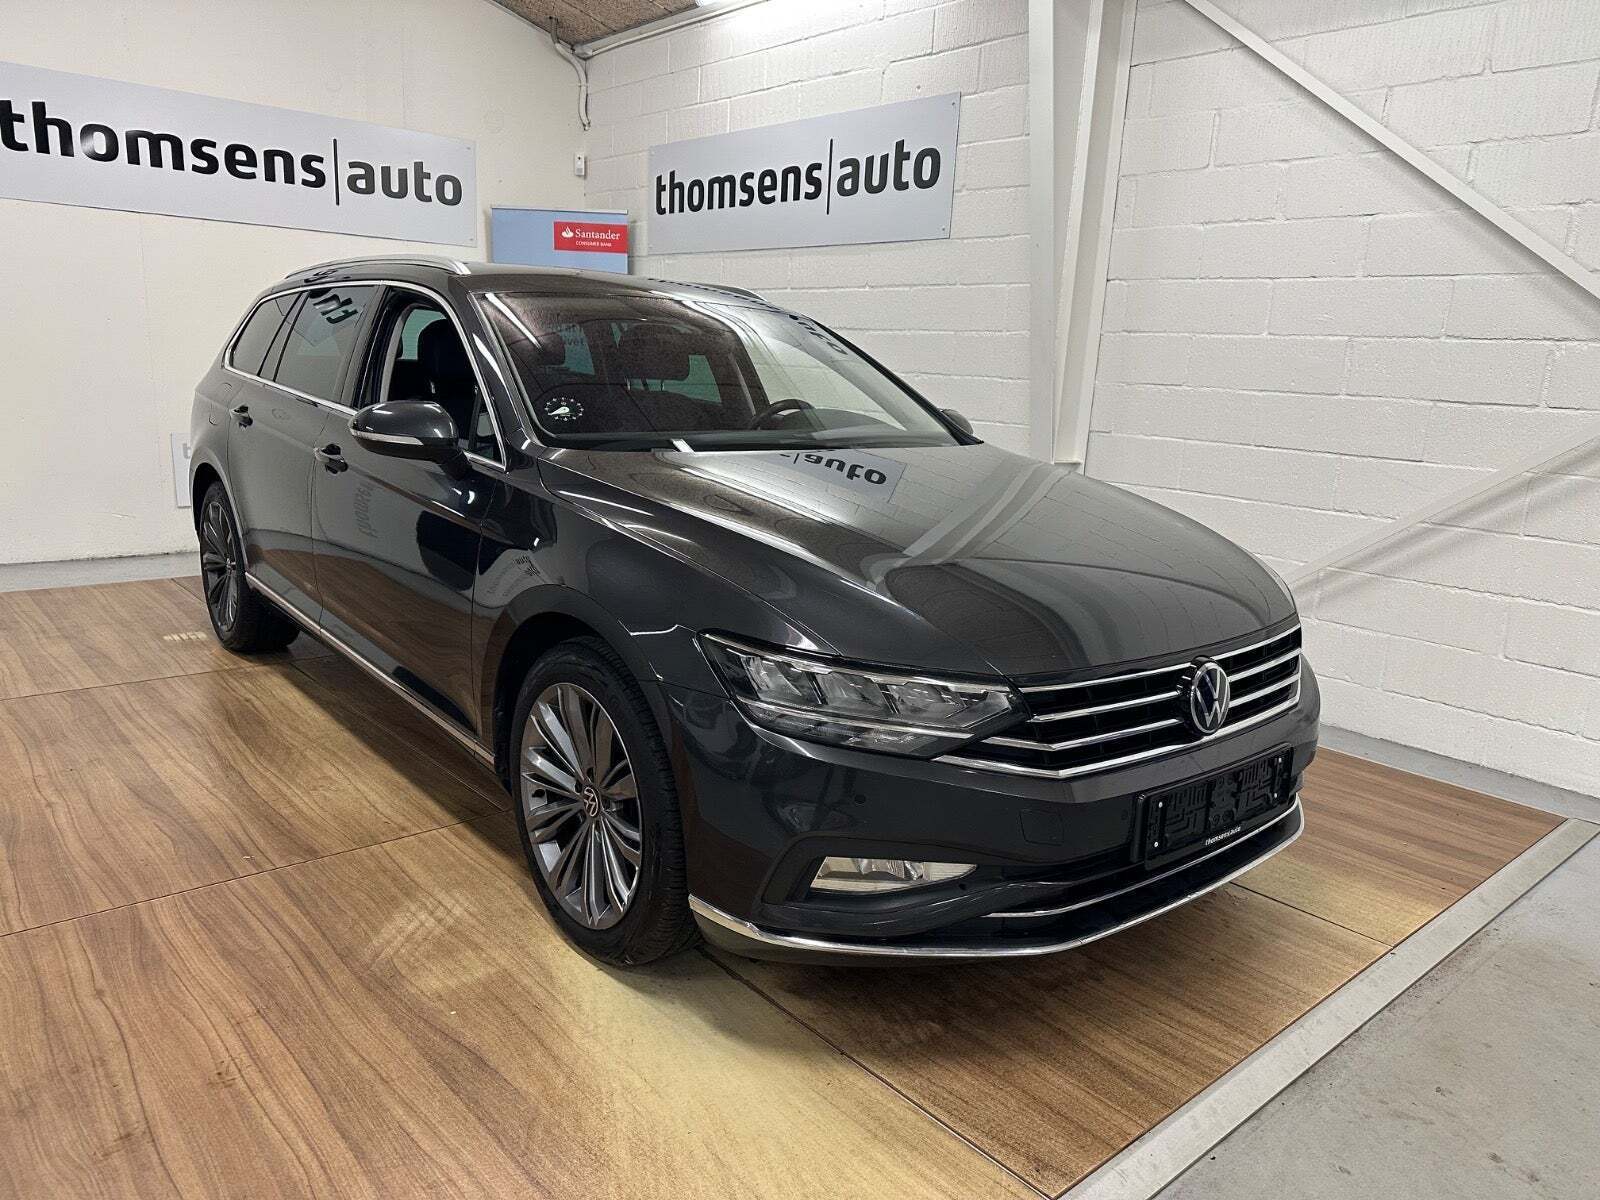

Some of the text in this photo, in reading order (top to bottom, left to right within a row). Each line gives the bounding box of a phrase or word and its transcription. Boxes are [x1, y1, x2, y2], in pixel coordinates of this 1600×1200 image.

[0, 99, 463, 206] thomsens auto
[655, 138, 942, 216] thomsens auto
[575, 229, 621, 240] Santander
